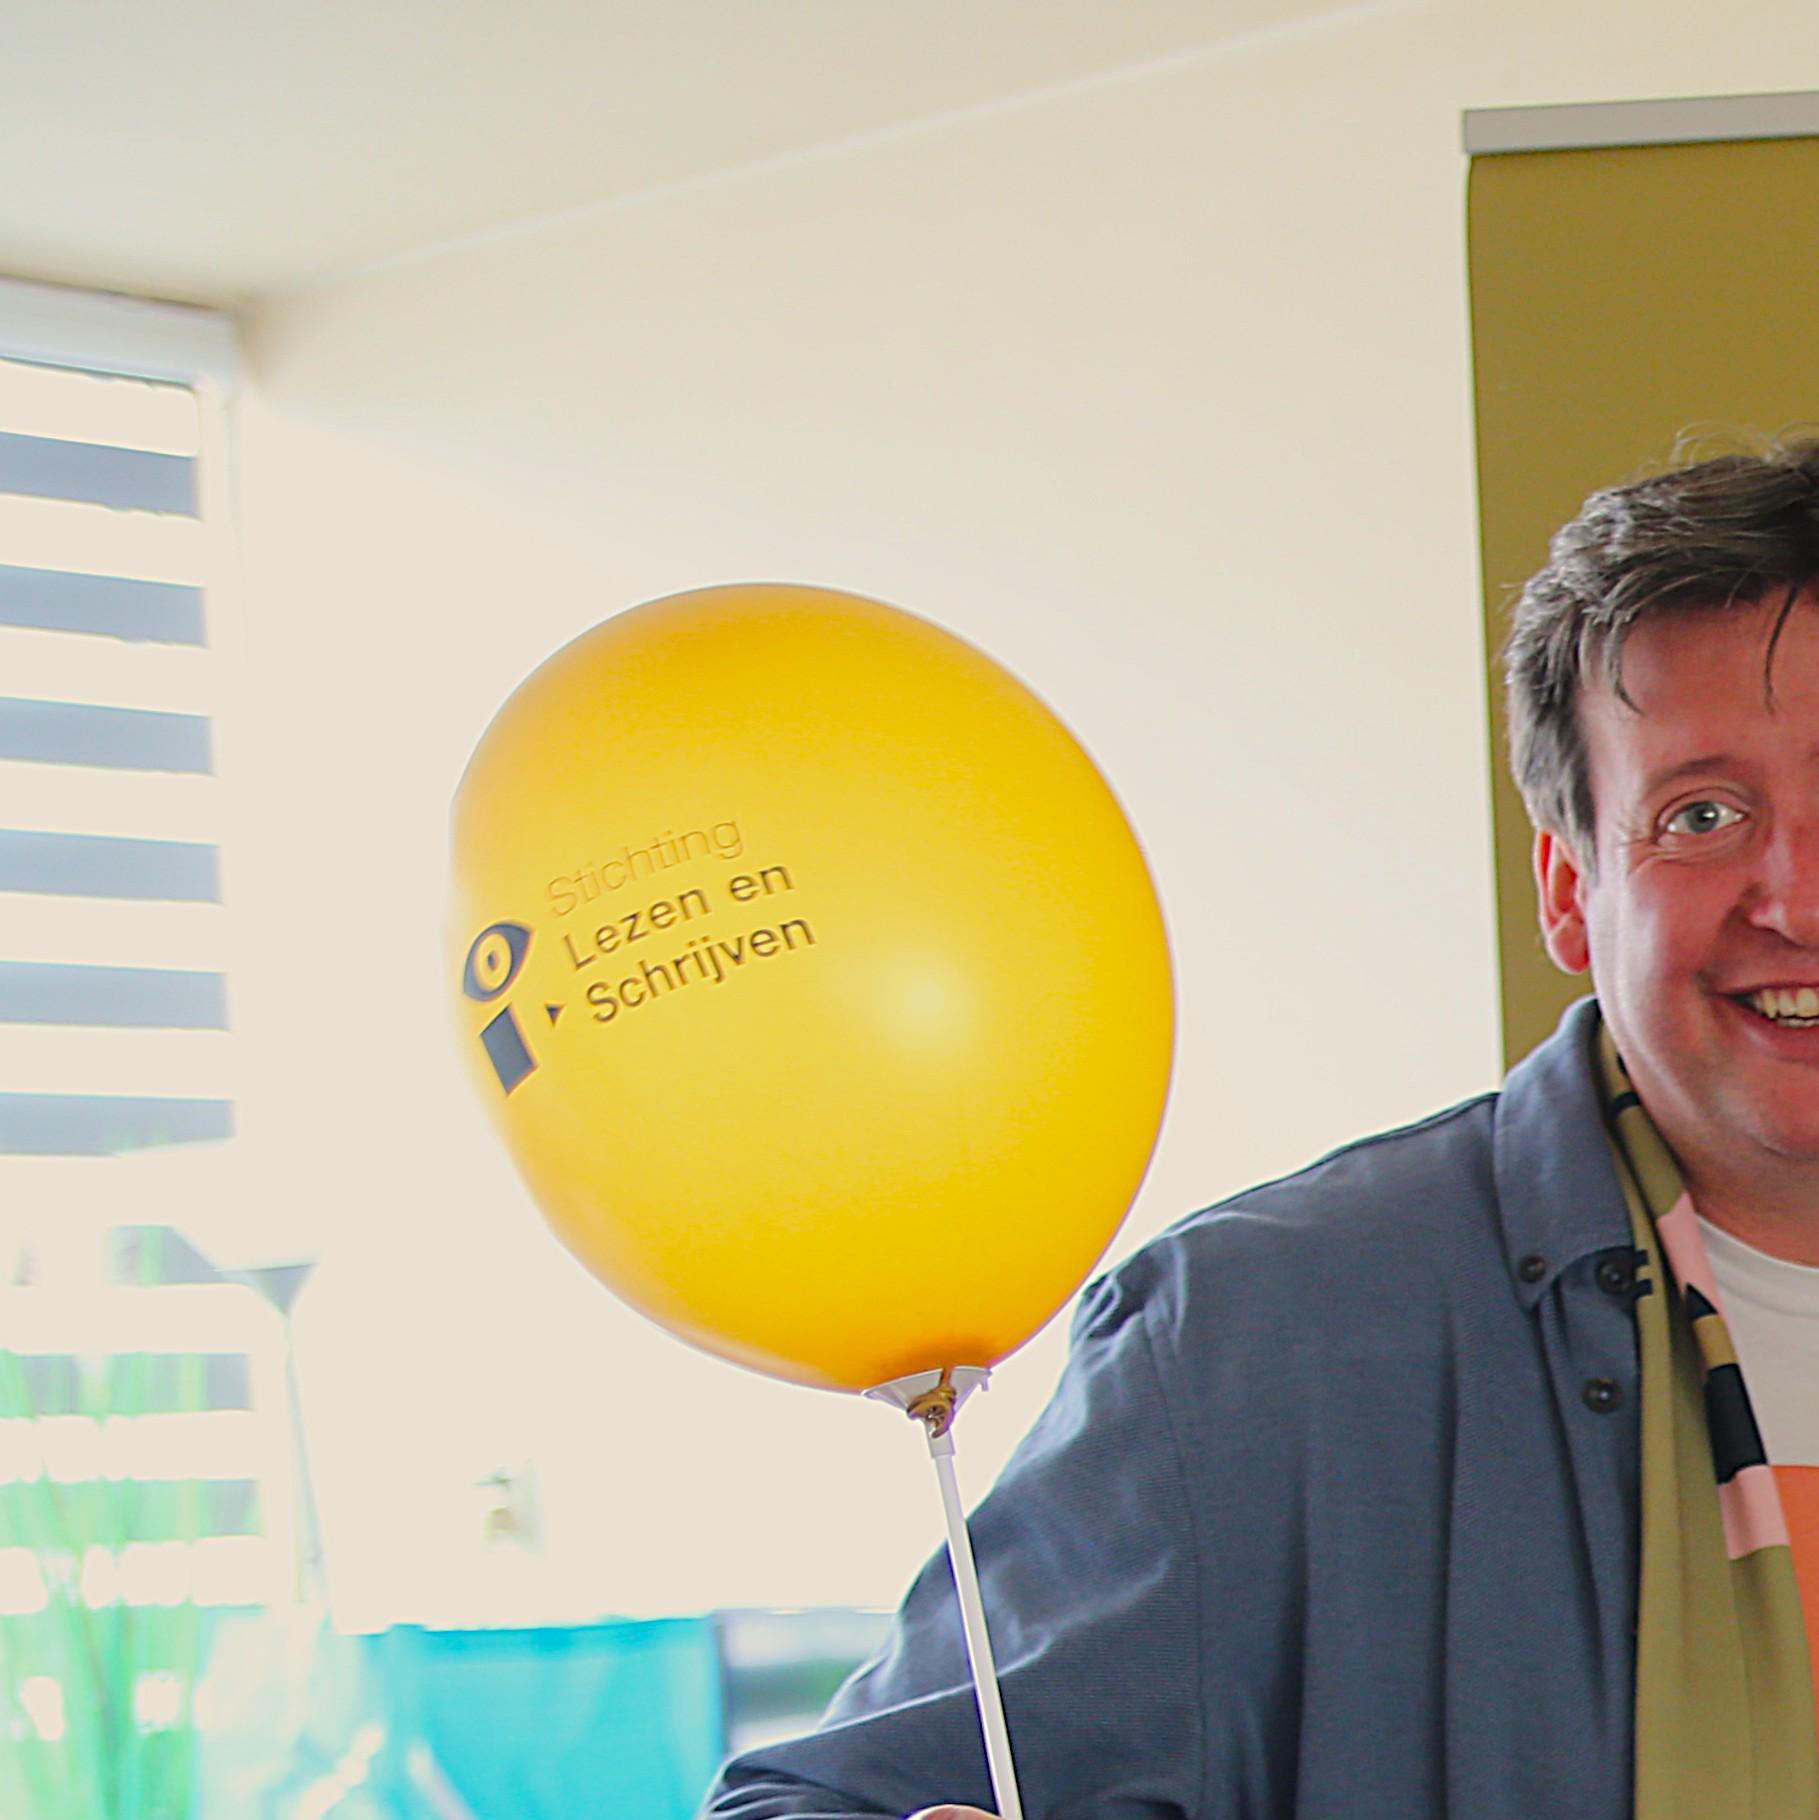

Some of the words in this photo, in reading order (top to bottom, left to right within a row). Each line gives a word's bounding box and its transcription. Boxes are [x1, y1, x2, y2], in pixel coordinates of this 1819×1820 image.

[545, 819, 745, 917] Stichting
[562, 887, 712, 972] Lezen
[728, 864, 796, 903] en
[585, 917, 818, 1024] Schrijven
